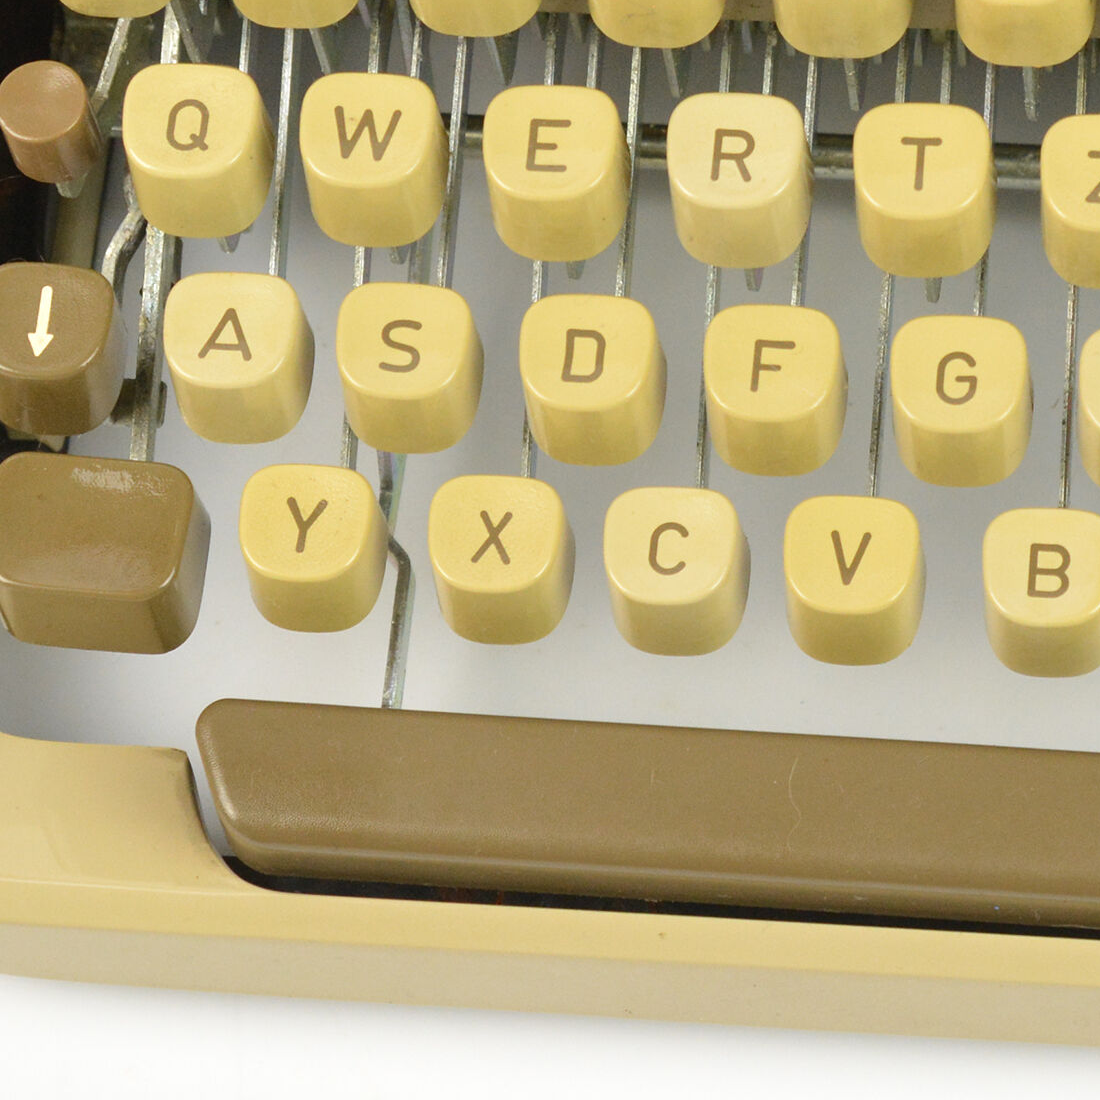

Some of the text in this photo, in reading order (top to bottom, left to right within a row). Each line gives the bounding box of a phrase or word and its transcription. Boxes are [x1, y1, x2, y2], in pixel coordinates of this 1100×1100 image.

[165, 98, 210, 152] Q
[333, 105, 403, 162] W
[525, 118, 572, 173] E
[710, 128, 756, 183] R
[900, 136, 943, 192] T
[197, 307, 253, 362] A
[378, 319, 423, 373] S
[560, 328, 607, 384] D
[749, 338, 797, 393] F
[935, 351, 978, 406] G
[287, 497, 328, 553] Y
[470, 509, 513, 566] X
[647, 521, 690, 576] C
[830, 529, 872, 586] V
[1026, 542, 1071, 599] B
